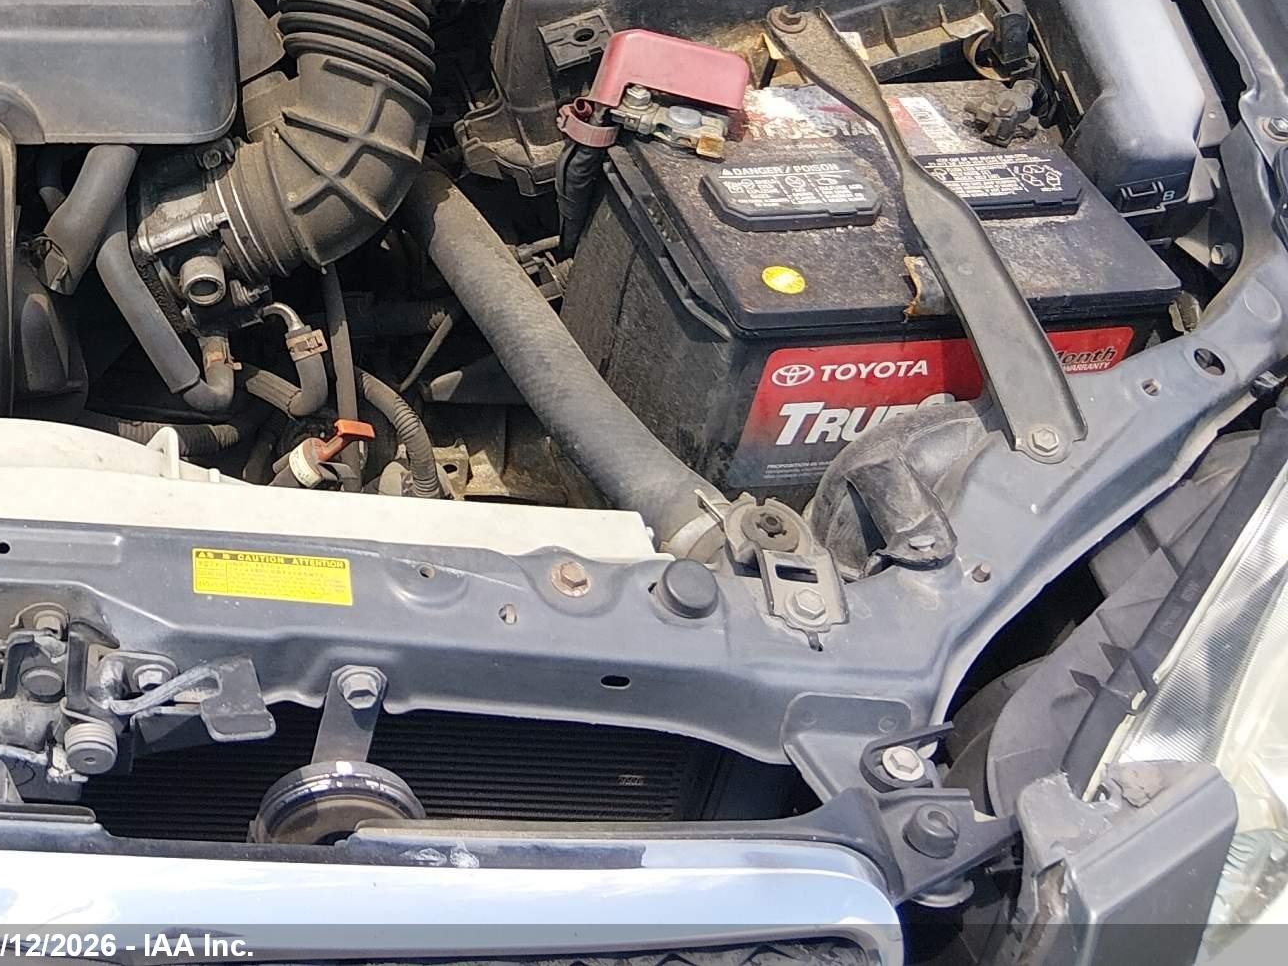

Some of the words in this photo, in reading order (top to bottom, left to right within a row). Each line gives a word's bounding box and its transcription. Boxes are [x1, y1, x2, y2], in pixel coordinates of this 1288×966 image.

[733, 166, 782, 176] DANGER
[793, 163, 840, 173] POISON
[820, 359, 929, 382] TOYOTA
[237, 553, 285, 564] CAUTION
[292, 557, 344, 569] ATTENTION
